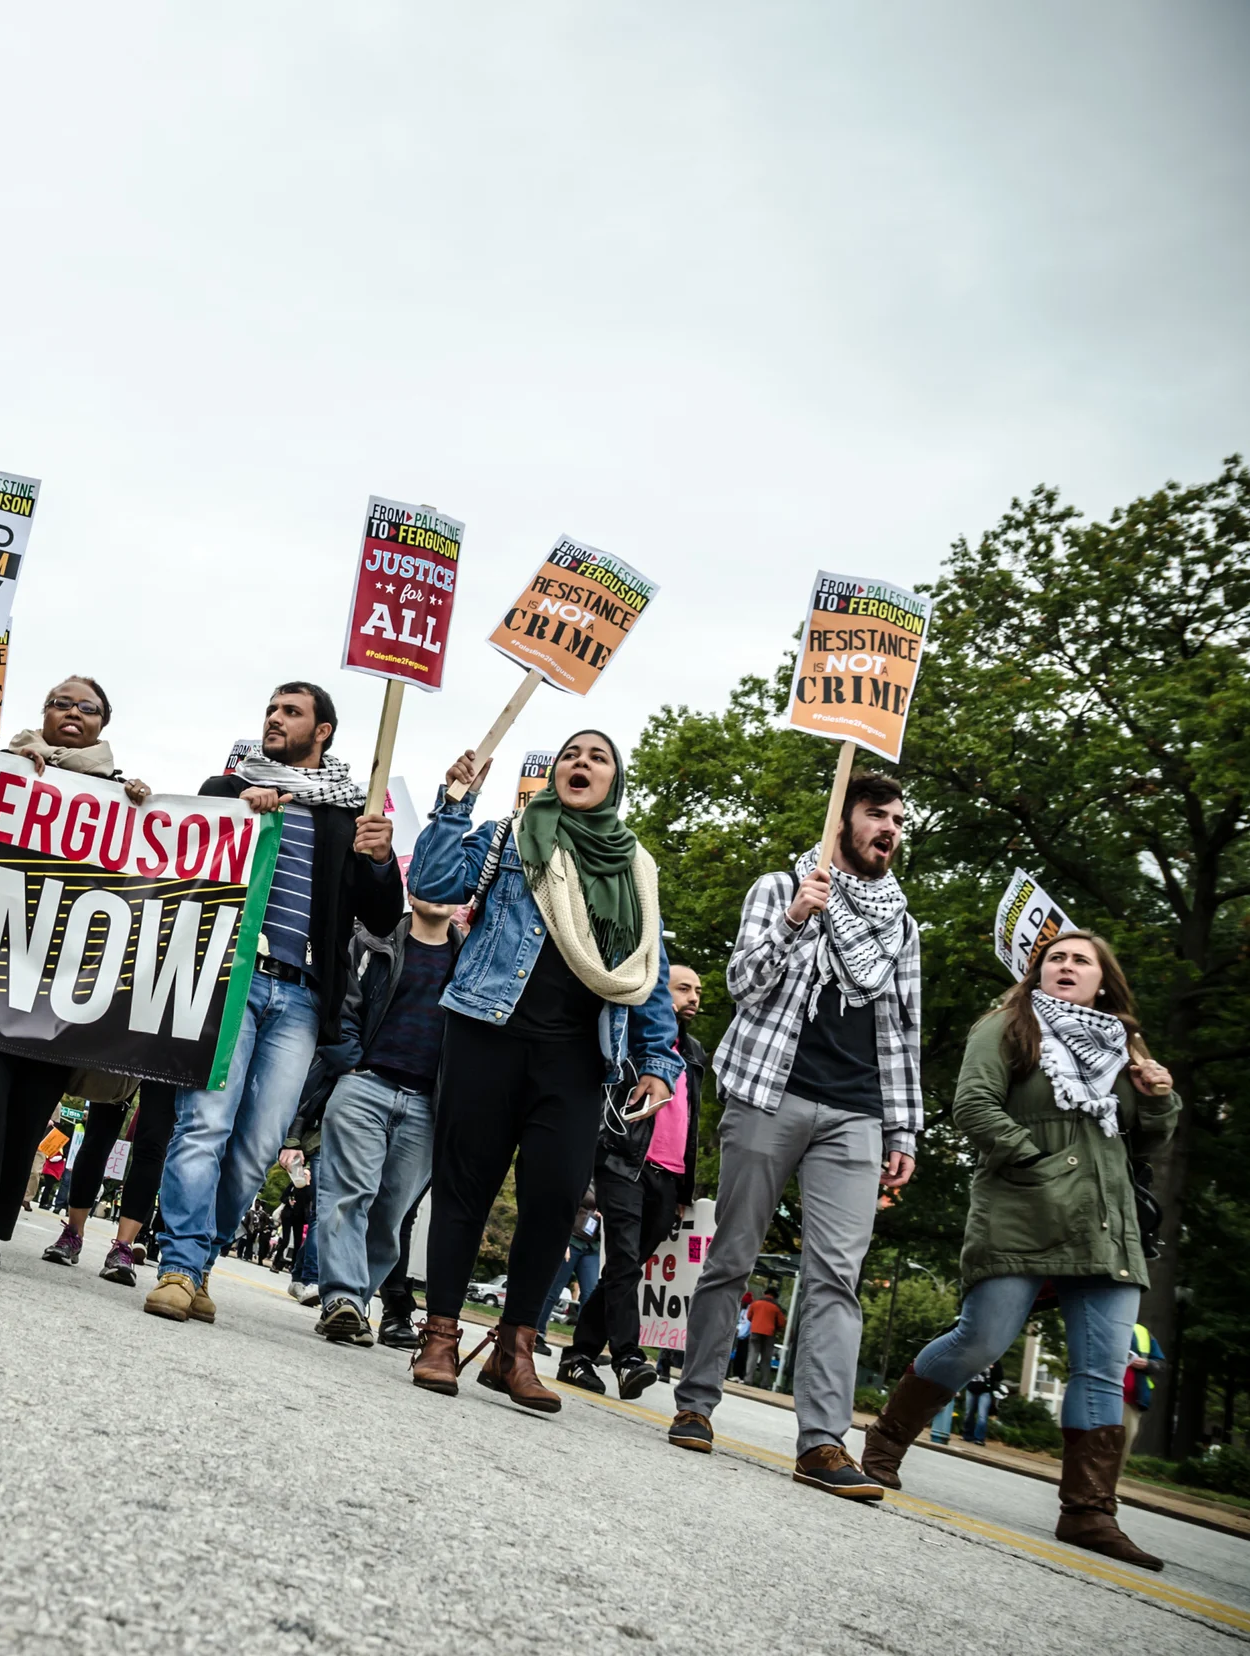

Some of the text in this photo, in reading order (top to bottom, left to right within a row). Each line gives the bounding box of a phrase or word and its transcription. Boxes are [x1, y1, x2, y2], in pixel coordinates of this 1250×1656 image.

[370, 518, 460, 561] TO FERGUSON
[371, 503, 461, 543] FROM PALESTINE
[365, 549, 455, 593] JUSTICE
[551, 551, 648, 612] TO FERGUSON
[557, 540, 655, 598] FROM PALESTINE
[400, 583, 425, 604] for
[530, 575, 636, 633] RESISTANCE
[817, 592, 925, 636] TO FERGUSON
[819, 578, 927, 617] FROM PALESTINE
[360, 602, 442, 655] ALL
[527, 598, 596, 634] IS NOT A
[503, 607, 613, 672] CRIME
[809, 628, 919, 664] RESISTANCE
[365, 649, 429, 673] #Palestine2Ferguson
[510, 639, 576, 683] #Palestine2Ferguson
[813, 653, 889, 678] IS NOT A
[796, 675, 909, 718] CRIME
[812, 712, 887, 740] #Palestine2Ferguson
[227, 755, 238, 769] TO
[232, 744, 250, 756] FROM
[525, 754, 553, 765] FROM
[524, 764, 539, 778] TO
[999, 874, 1026, 926] PALESTINE
[1004, 882, 1035, 946] FERGUSON
[1017, 907, 1044, 976] END
[642, 1283, 690, 1319] No
